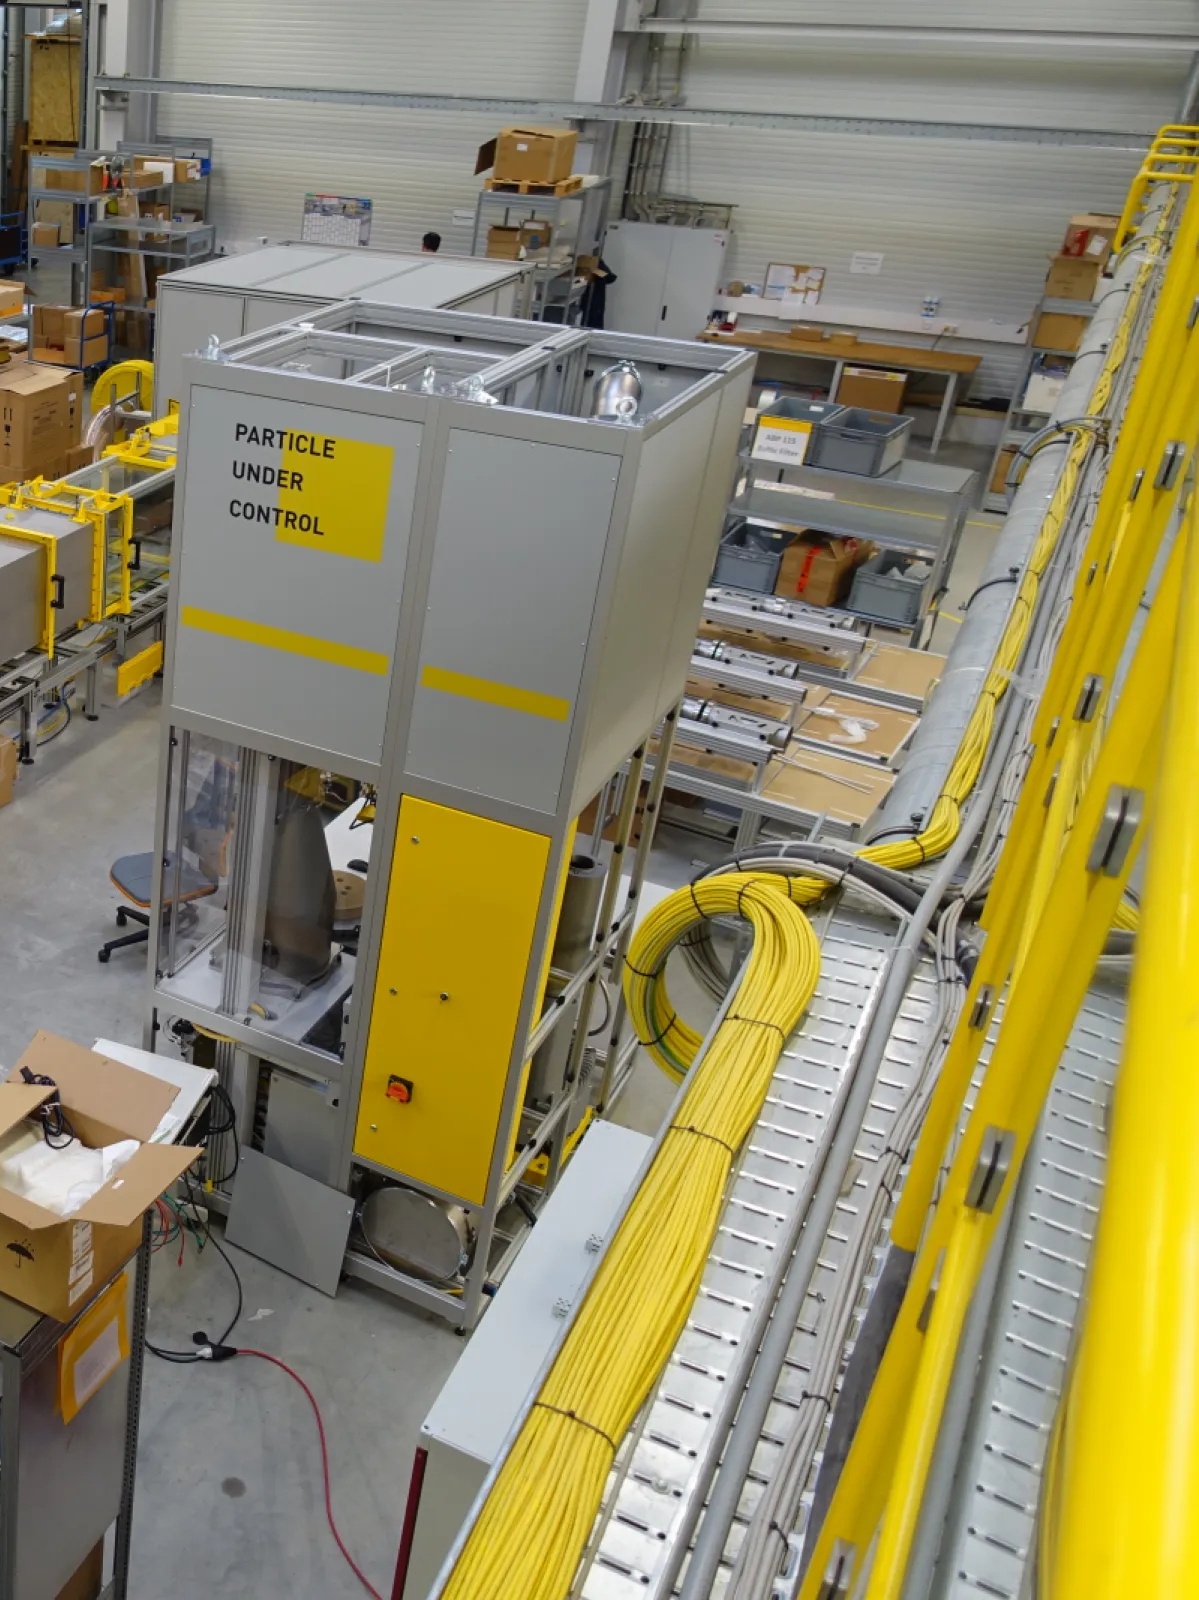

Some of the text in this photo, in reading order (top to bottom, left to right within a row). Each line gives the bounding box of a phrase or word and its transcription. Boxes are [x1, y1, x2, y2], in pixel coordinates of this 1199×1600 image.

[235, 423, 336, 459] PARTICLE
[232, 460, 303, 491] UNDER
[229, 499, 324, 536] CONTROL
